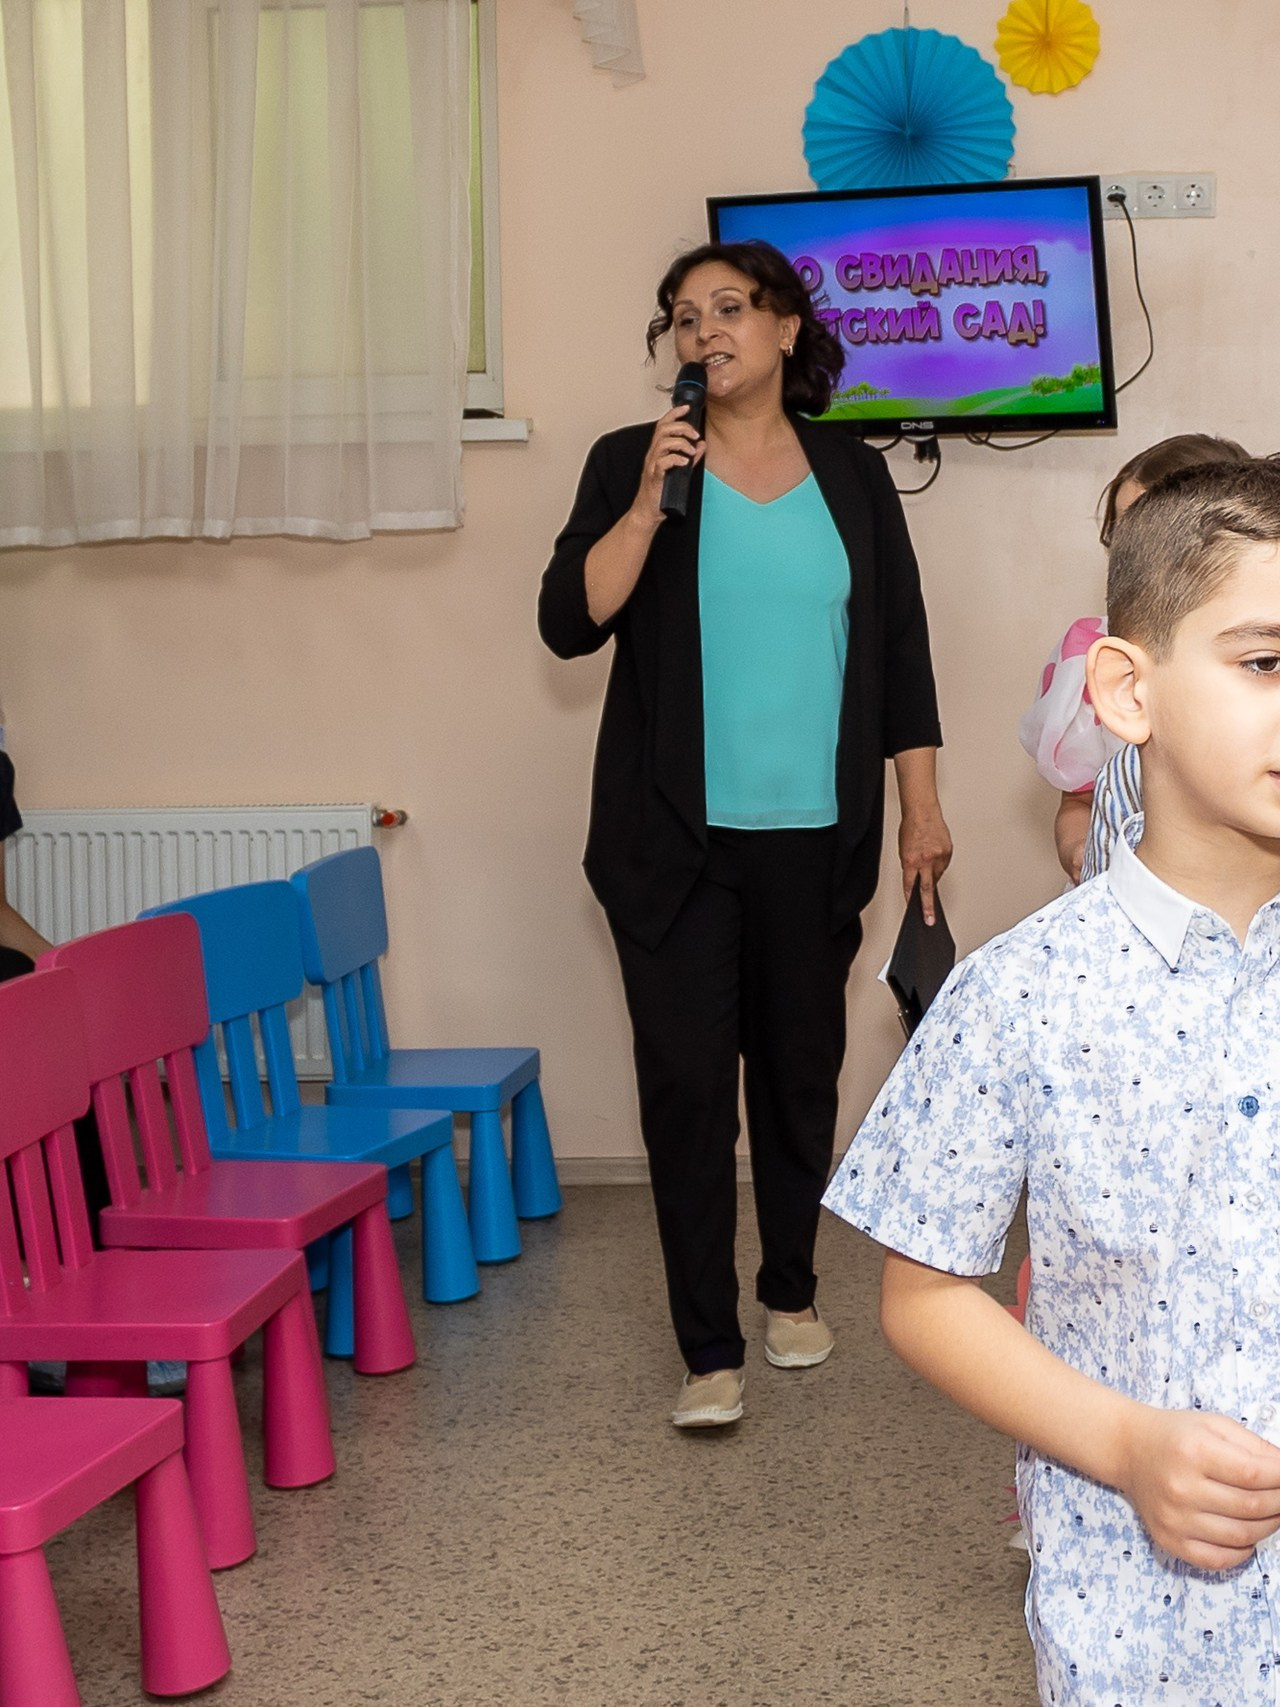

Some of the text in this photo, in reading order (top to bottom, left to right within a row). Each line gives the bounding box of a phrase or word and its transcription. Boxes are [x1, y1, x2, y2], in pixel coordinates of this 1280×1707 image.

[792, 245, 1048, 295] О СВИДАНИЯ,
[813, 299, 1045, 346] ТСКИЙ САД!
[900, 421, 934, 430] DNS
